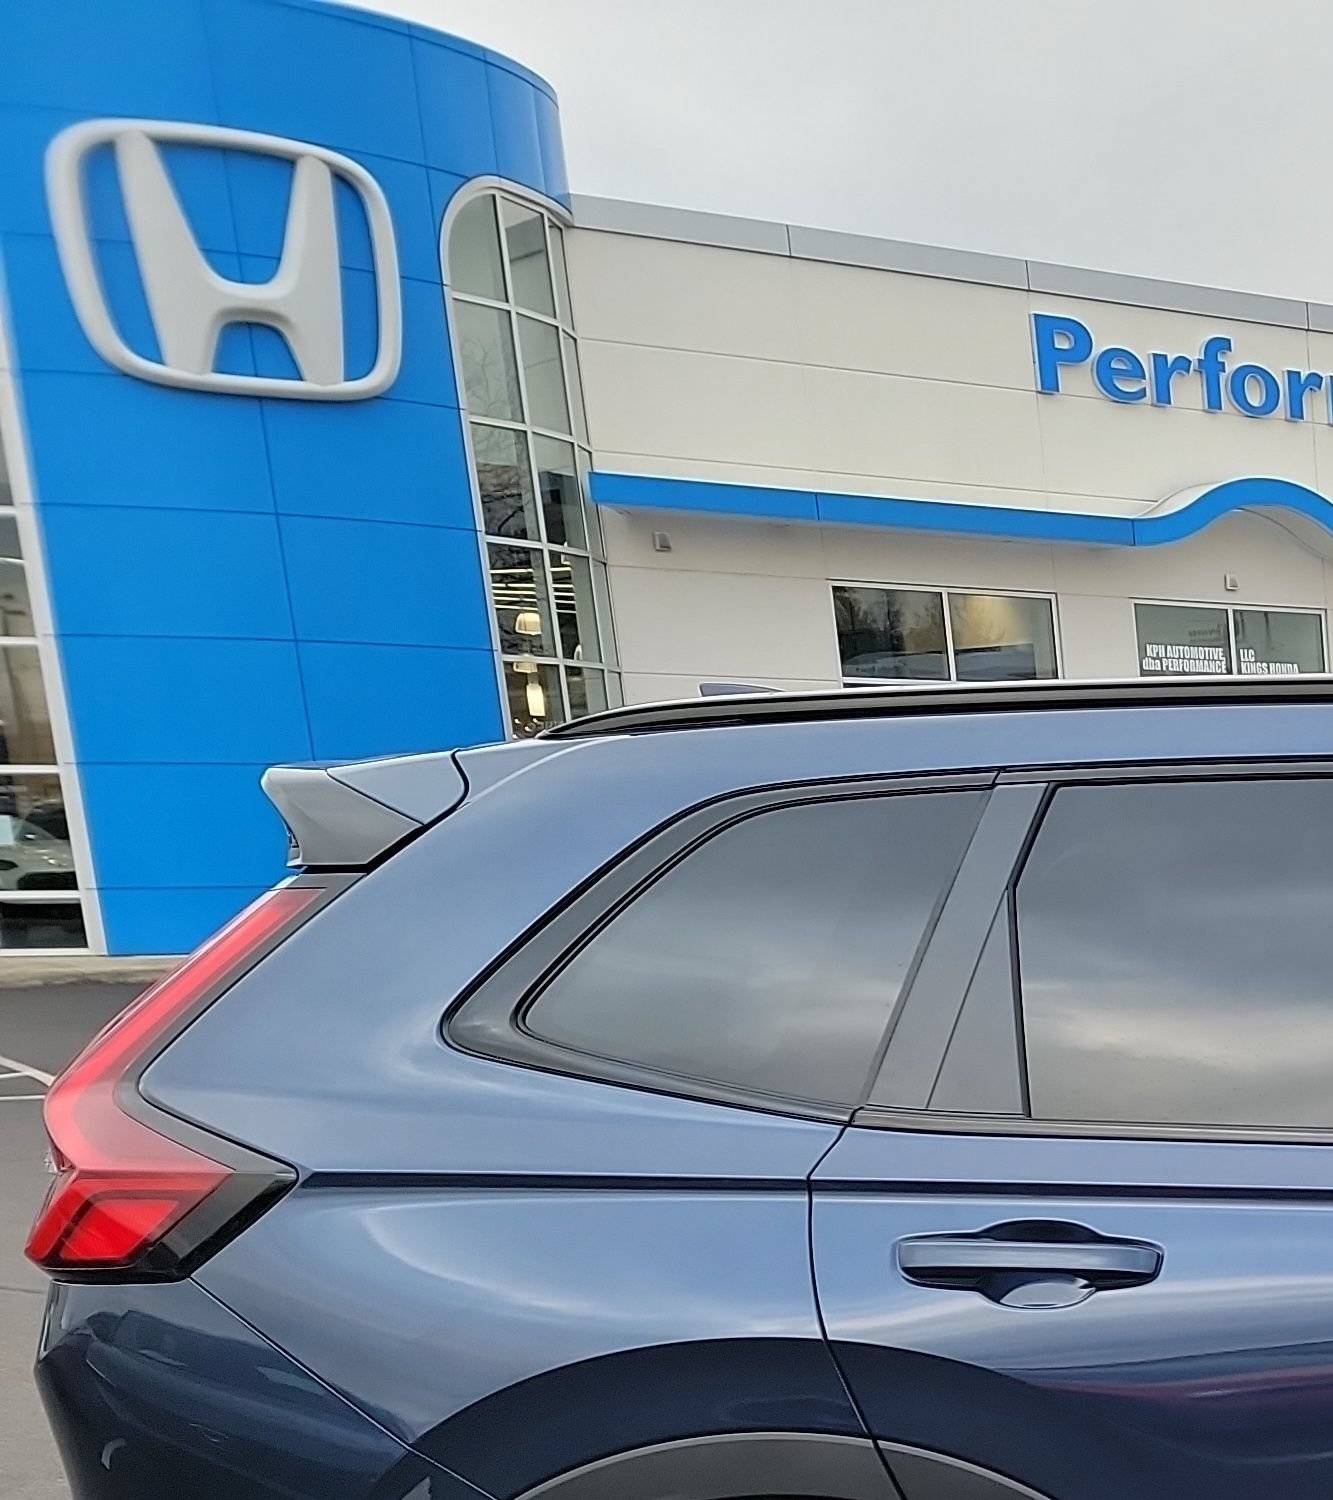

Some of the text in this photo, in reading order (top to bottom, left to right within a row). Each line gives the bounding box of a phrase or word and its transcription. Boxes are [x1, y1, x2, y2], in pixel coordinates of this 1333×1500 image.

[1146, 643, 1165, 658] KPH
[1239, 649, 1255, 662] LLC
[1162, 658, 1227, 674] PERFORMANCE
[1240, 661, 1268, 675] KINGS
[1269, 662, 1299, 675] HONDA
